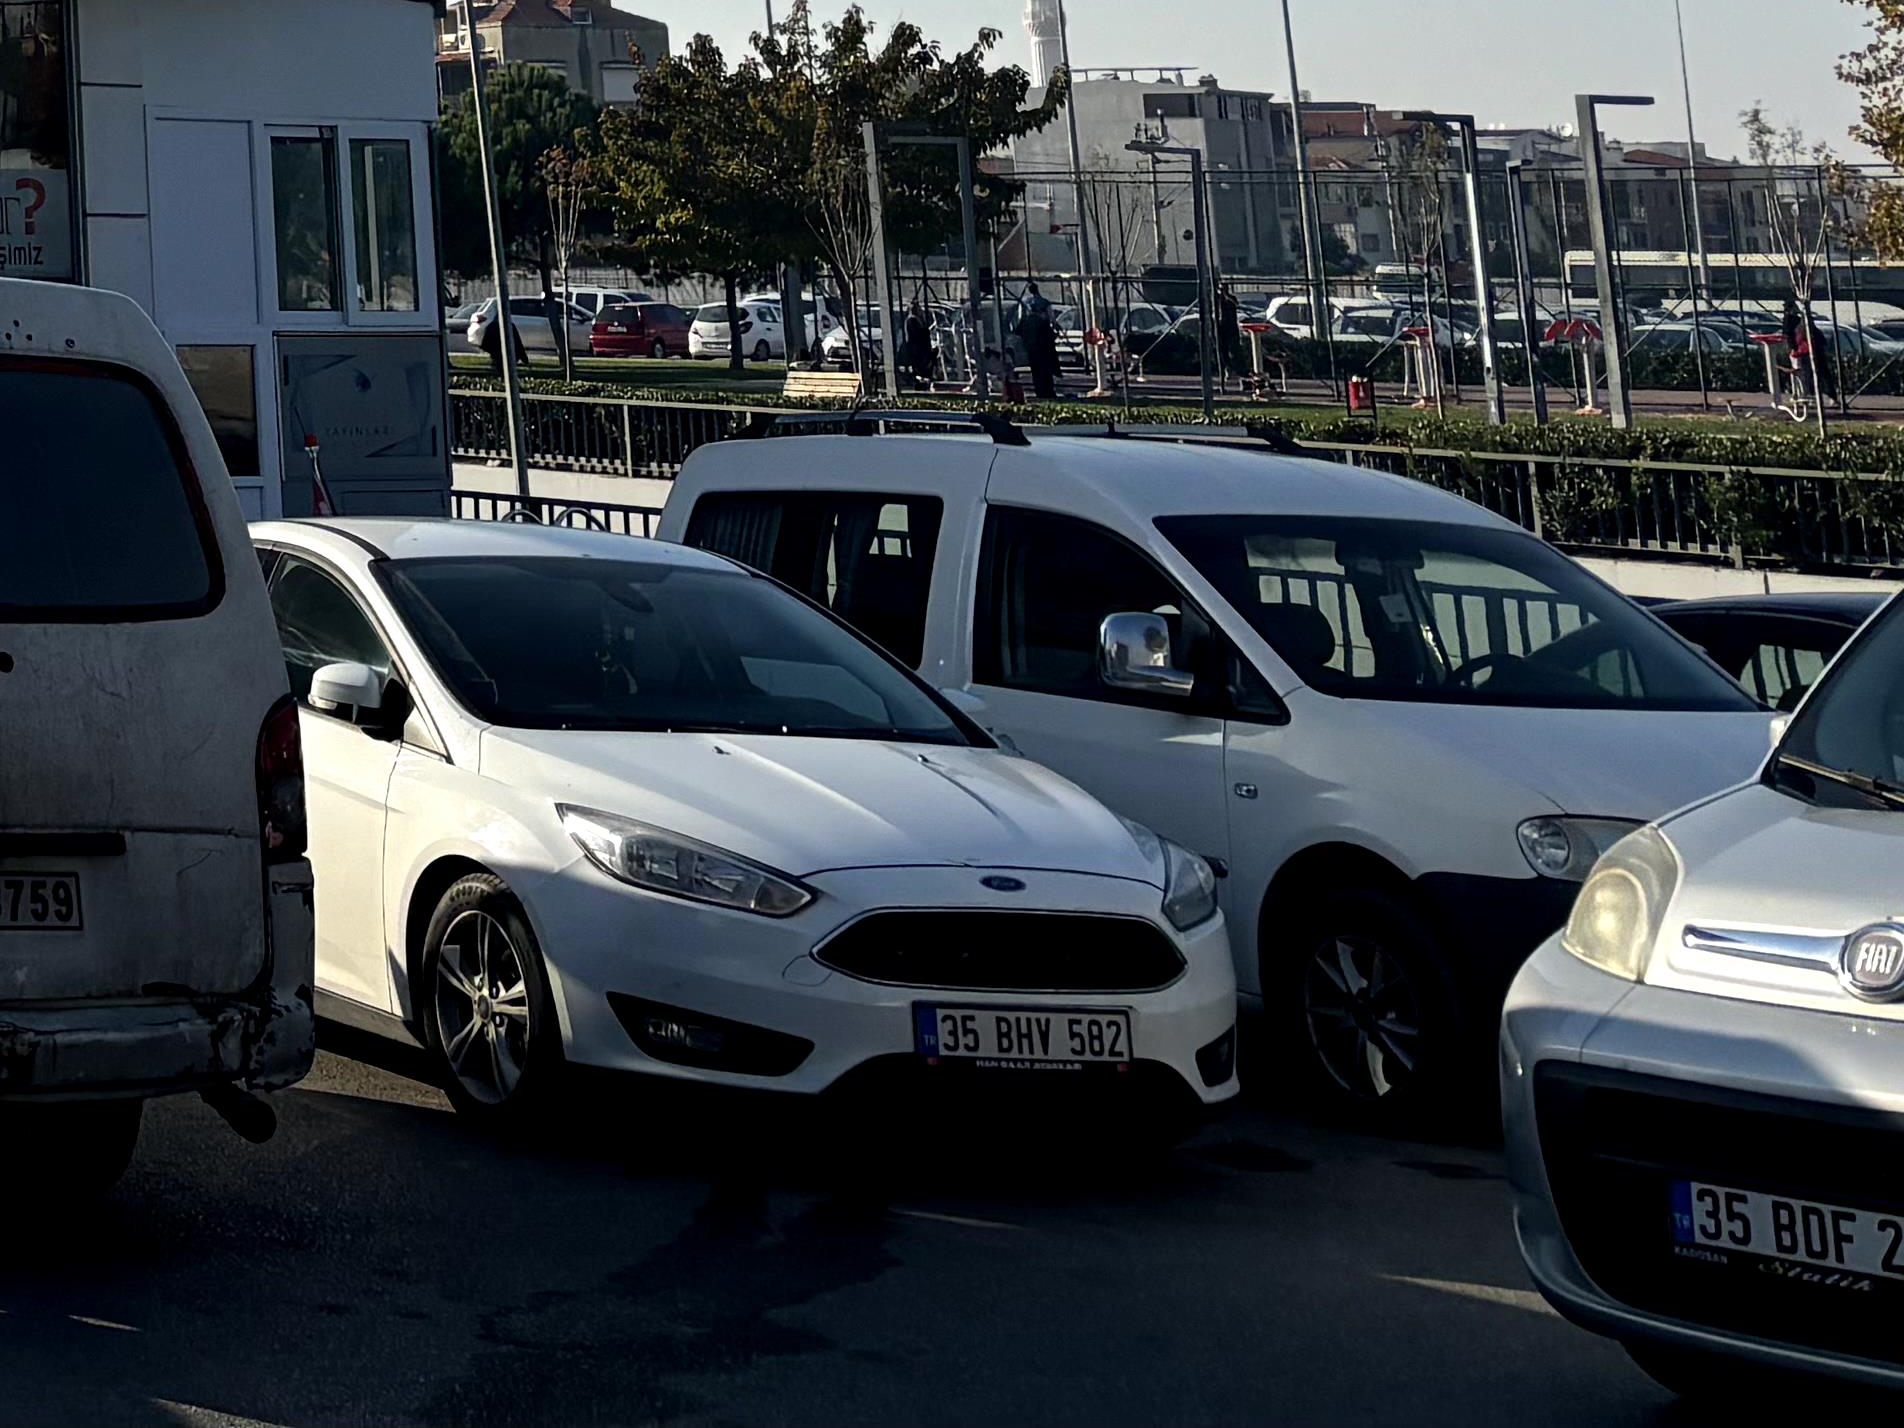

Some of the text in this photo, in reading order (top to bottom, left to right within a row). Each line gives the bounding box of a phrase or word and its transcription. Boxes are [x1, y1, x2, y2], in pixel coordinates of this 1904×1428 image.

[1856, 942, 1897, 974] FIAT
[941, 1014, 1124, 1057] 35 BHV 582
[1696, 1188, 1751, 1247] 35
